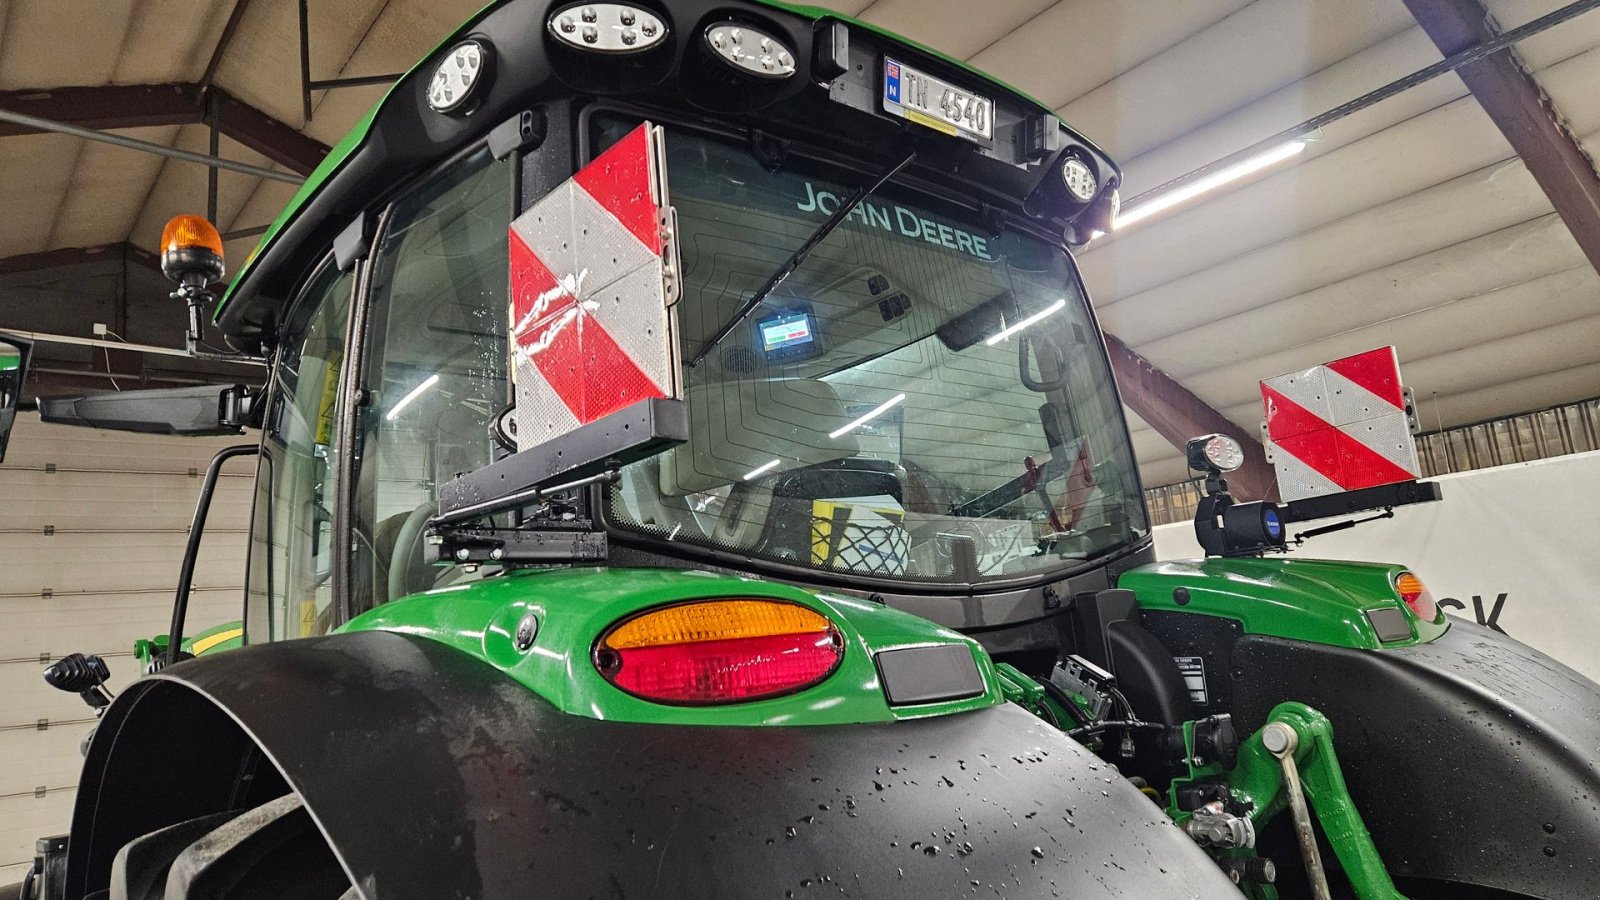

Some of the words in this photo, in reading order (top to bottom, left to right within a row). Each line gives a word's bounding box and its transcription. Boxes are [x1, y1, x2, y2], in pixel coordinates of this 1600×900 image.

[889, 84, 897, 96] N
[940, 88, 985, 131] 4540
[894, 206, 991, 259] DEERE
